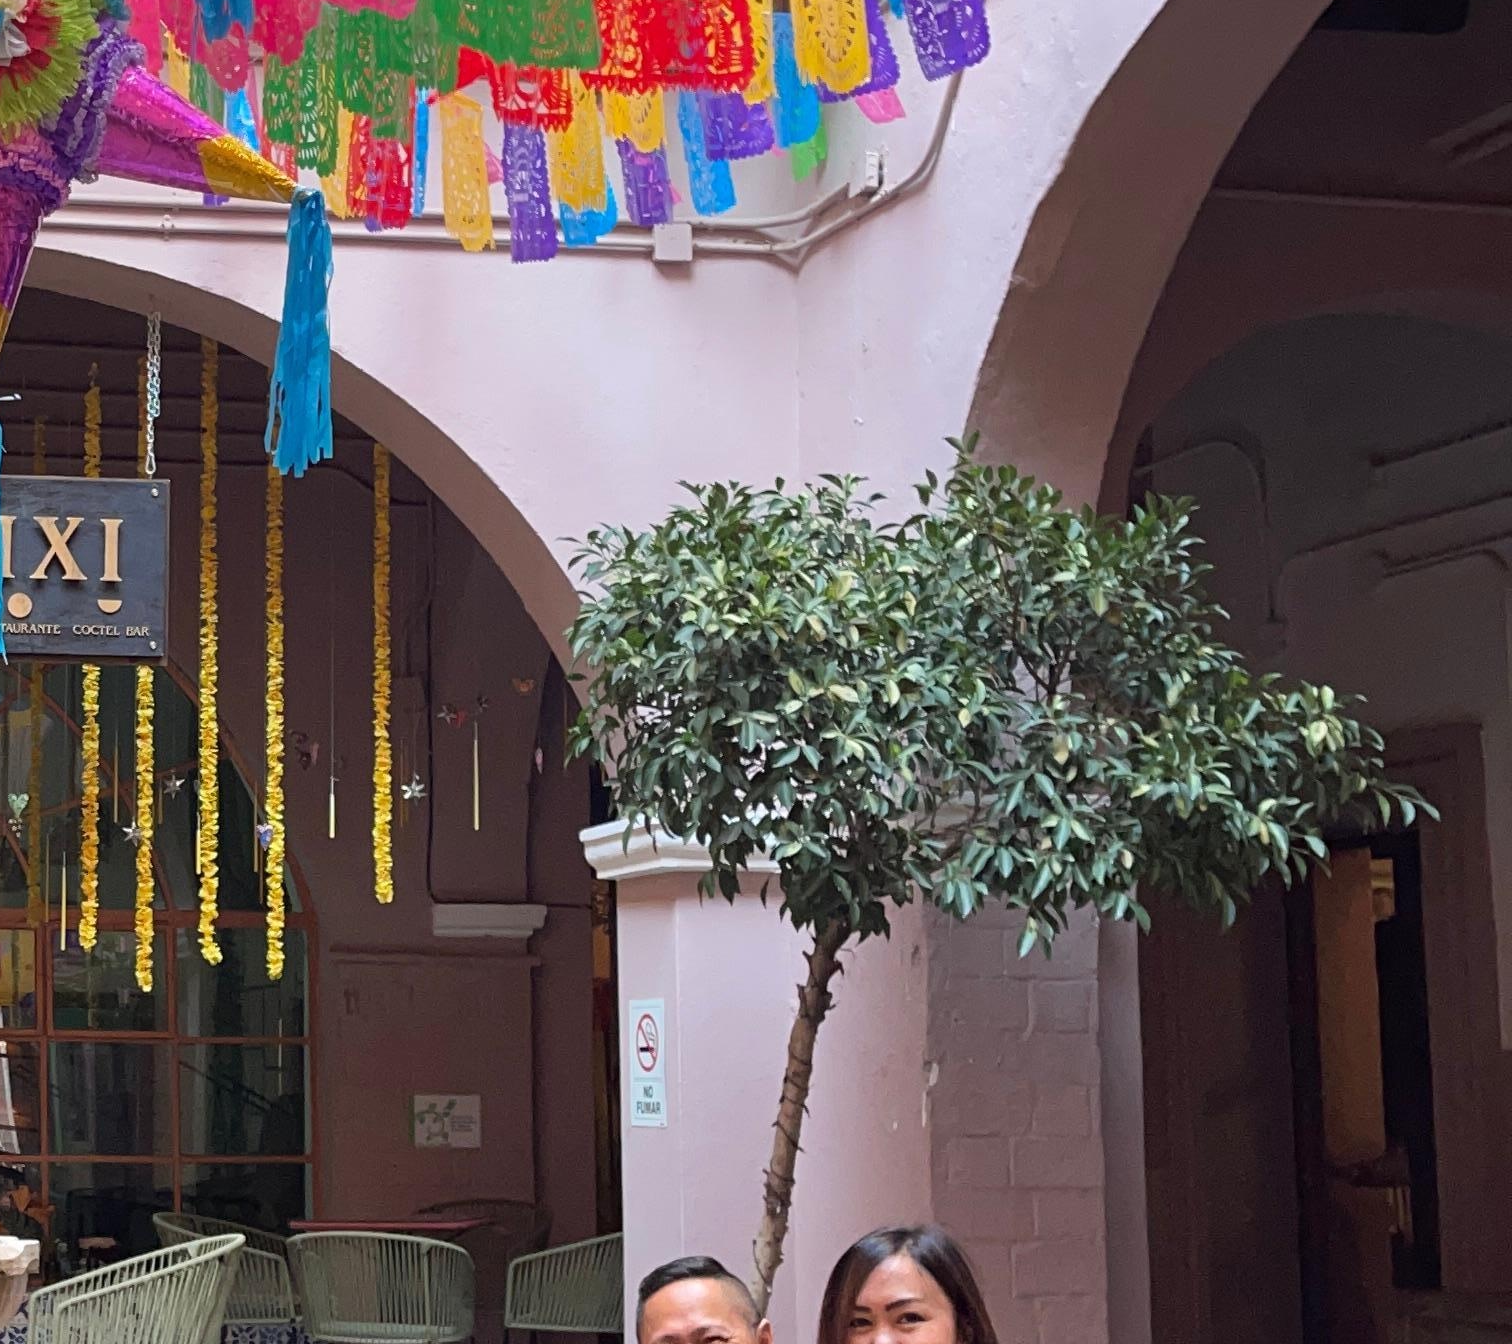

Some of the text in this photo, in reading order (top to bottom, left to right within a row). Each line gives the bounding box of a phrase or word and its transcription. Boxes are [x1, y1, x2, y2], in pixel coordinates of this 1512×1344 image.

[0, 623, 61, 635] TAURANTE
[72, 624, 120, 636] COCTEL
[125, 626, 150, 637] BAR
[643, 1086, 654, 1098] NO
[636, 1101, 661, 1114] FUMAR
